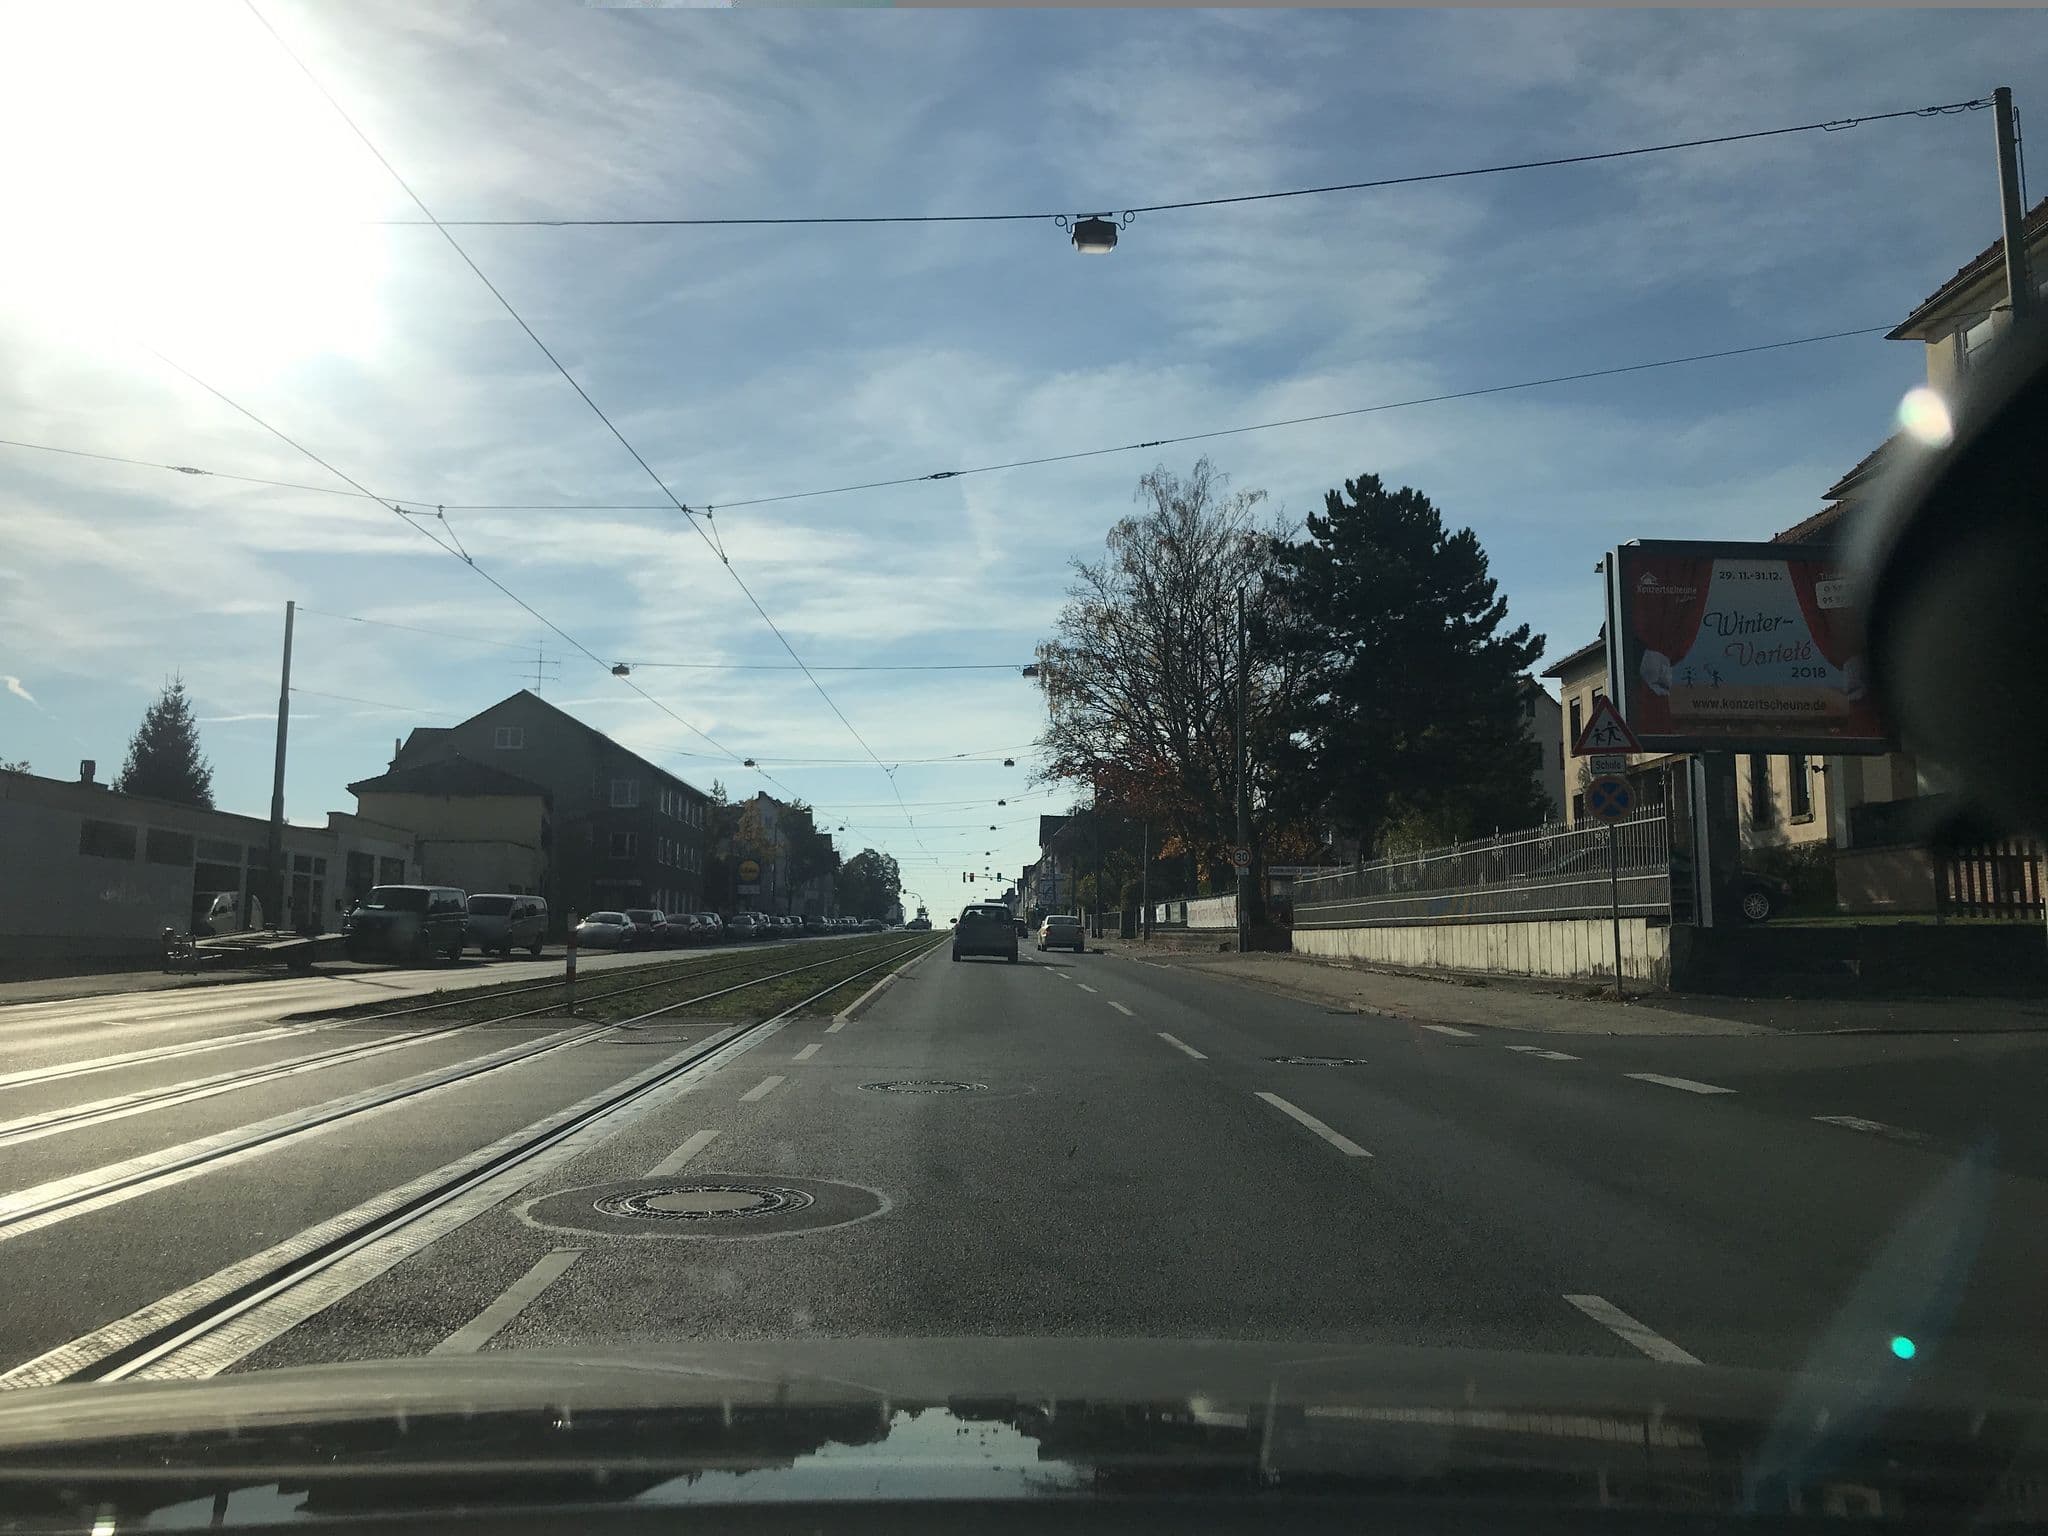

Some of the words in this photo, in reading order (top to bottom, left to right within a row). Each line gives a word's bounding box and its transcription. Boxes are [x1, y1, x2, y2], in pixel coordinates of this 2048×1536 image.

[1703, 611, 1794, 637] Winter-
[1791, 666, 1827, 679] 2018
[1692, 698, 1826, 712] www.konzertscheune.de
[1595, 759, 1622, 770] Schule
[1235, 852, 1248, 862] 30
